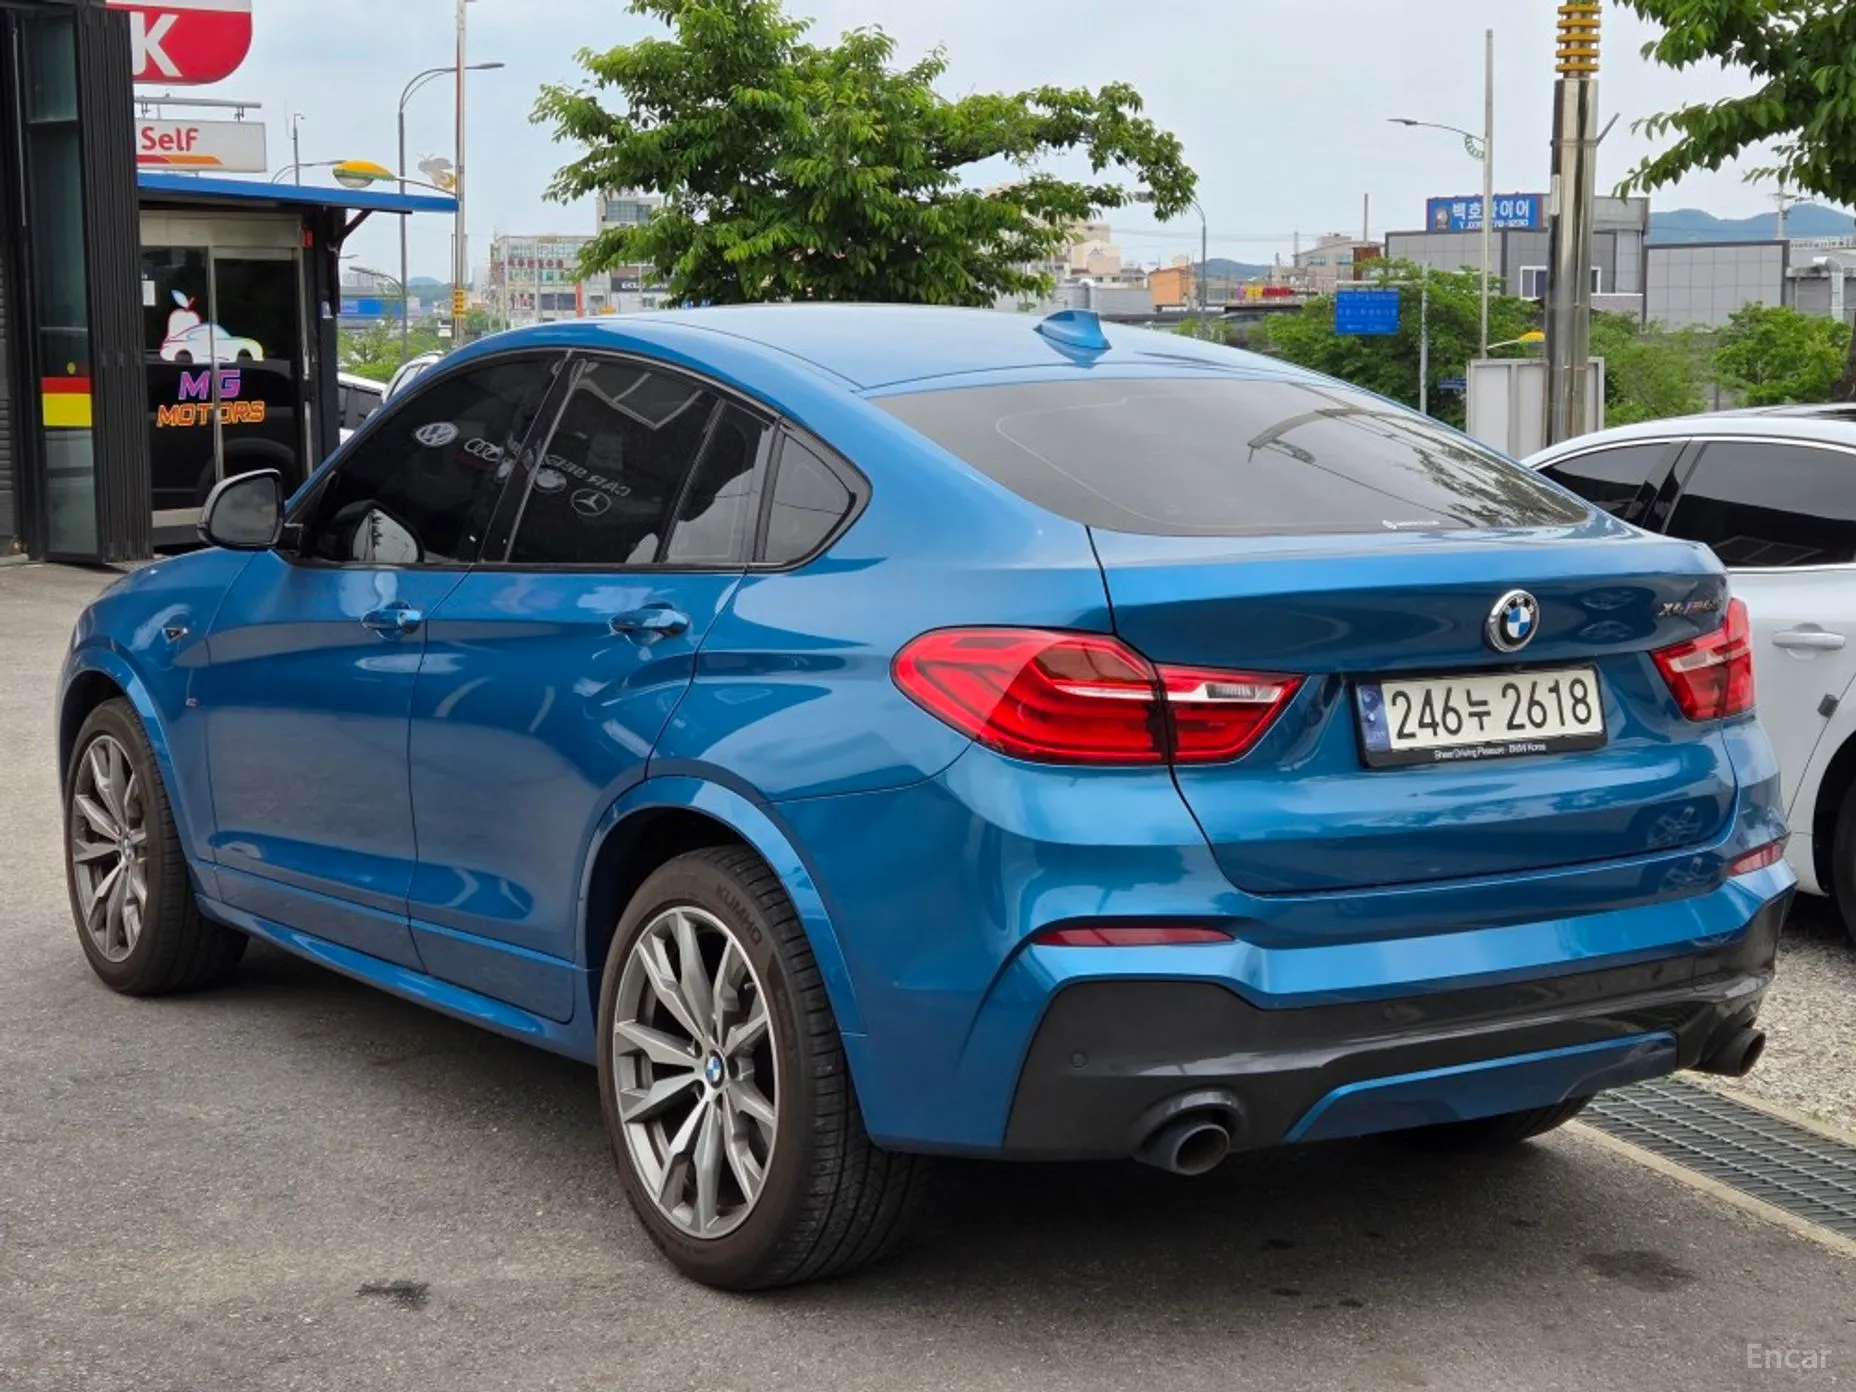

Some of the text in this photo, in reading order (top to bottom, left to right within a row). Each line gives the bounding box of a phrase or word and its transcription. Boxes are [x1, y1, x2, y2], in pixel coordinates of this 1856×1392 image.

[140, 126, 199, 152] Self
[178, 369, 241, 400] MG
[156, 401, 265, 428] MOTORS
[1391, 677, 1592, 740] 246누 2618
[715, 884, 763, 946] KUMHO
